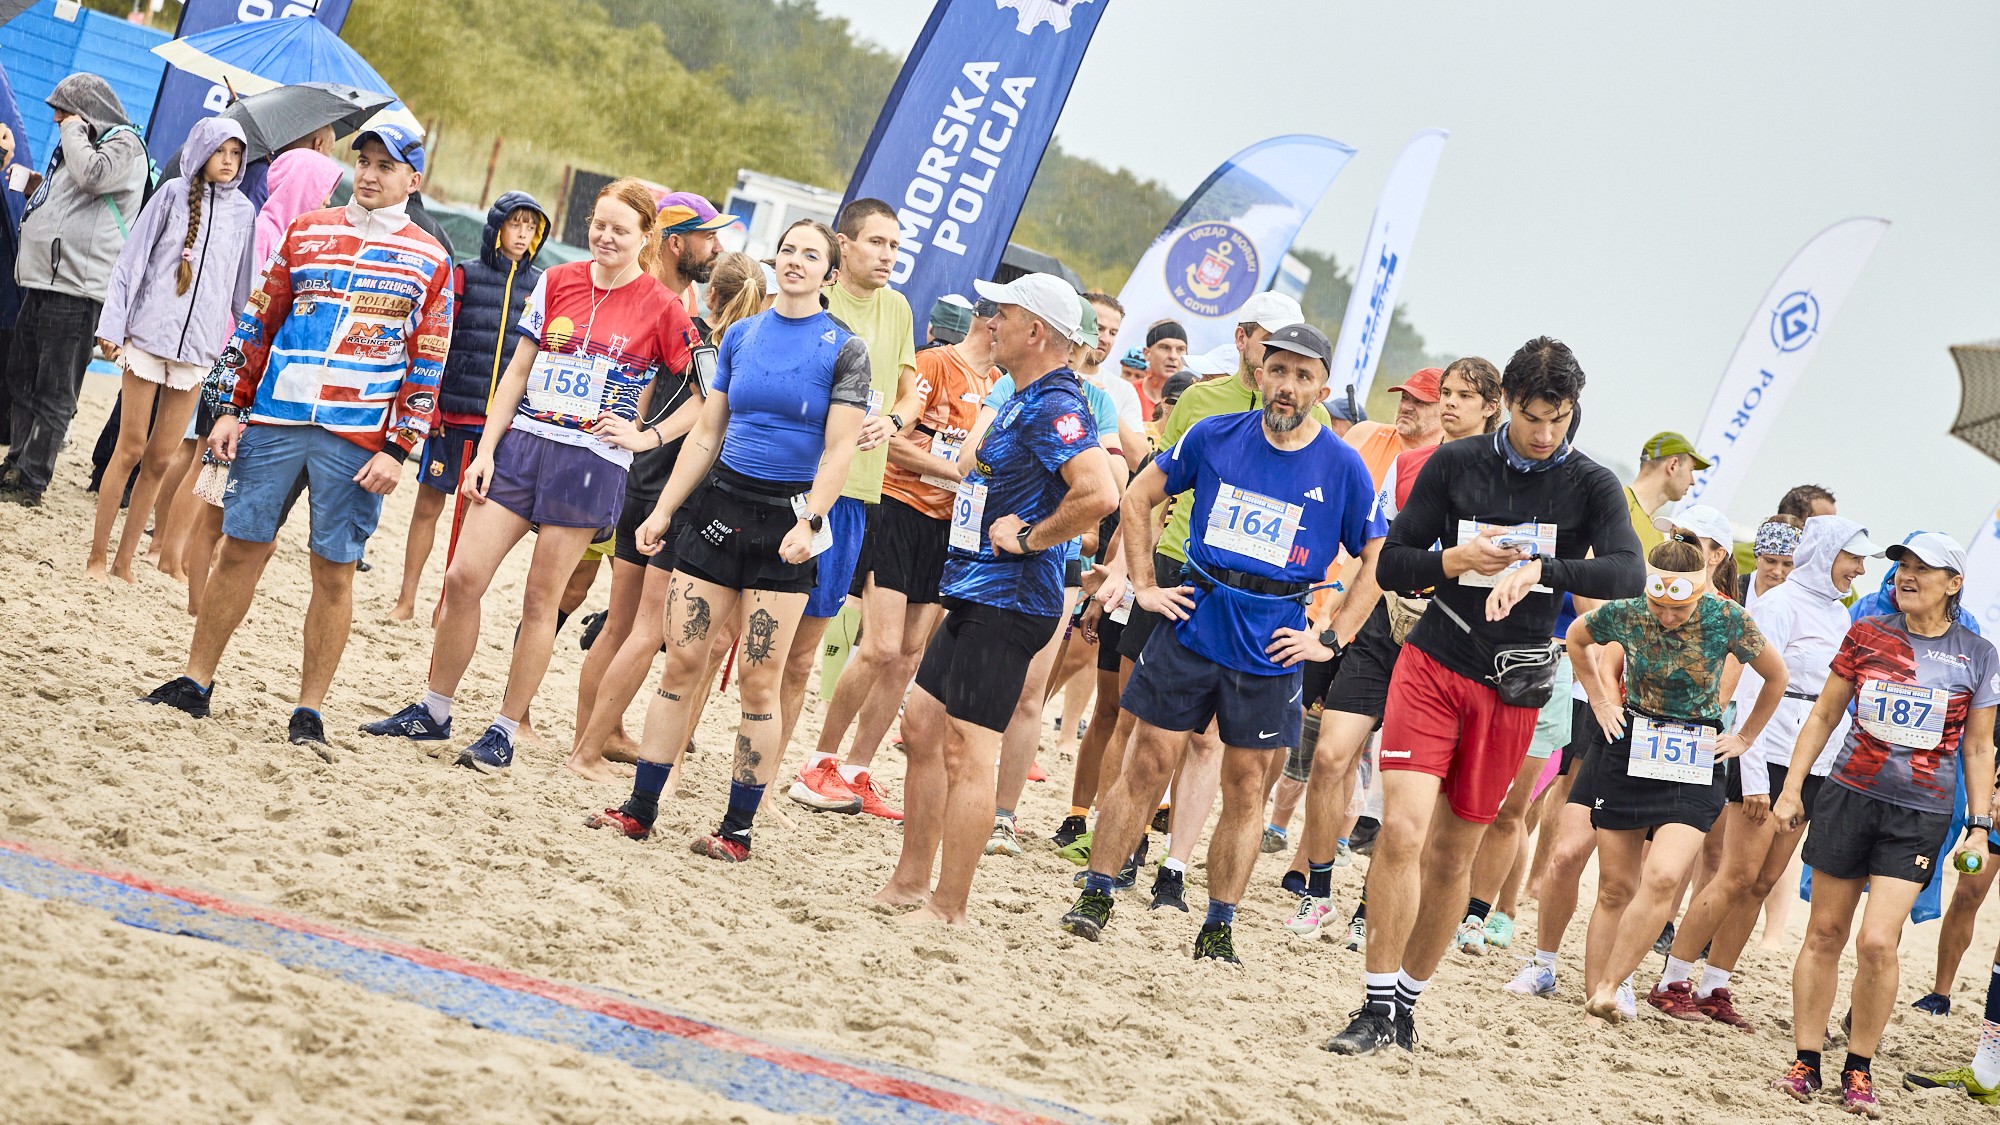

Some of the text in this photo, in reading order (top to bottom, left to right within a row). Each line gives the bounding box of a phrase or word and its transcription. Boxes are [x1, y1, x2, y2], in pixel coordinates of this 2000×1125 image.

[886, 61, 1000, 287] OMORSKA
[931, 76, 1037, 256] POLICJA
[1188, 226, 1257, 273] URZĄD MORSKI
[354, 277, 378, 289] AMK
[1183, 297, 1219, 315] GDYNI
[346, 336, 383, 346] RACING
[347, 321, 402, 341] MX
[543, 368, 592, 398] 158
[1724, 368, 1775, 446] PORT
[706, 524, 725, 543] RESS
[712, 519, 733, 535] COMP
[1228, 505, 1283, 543] 164
[1287, 544, 1310, 567] UN
[1874, 697, 1933, 728] 187
[1647, 736, 1698, 765] 151
